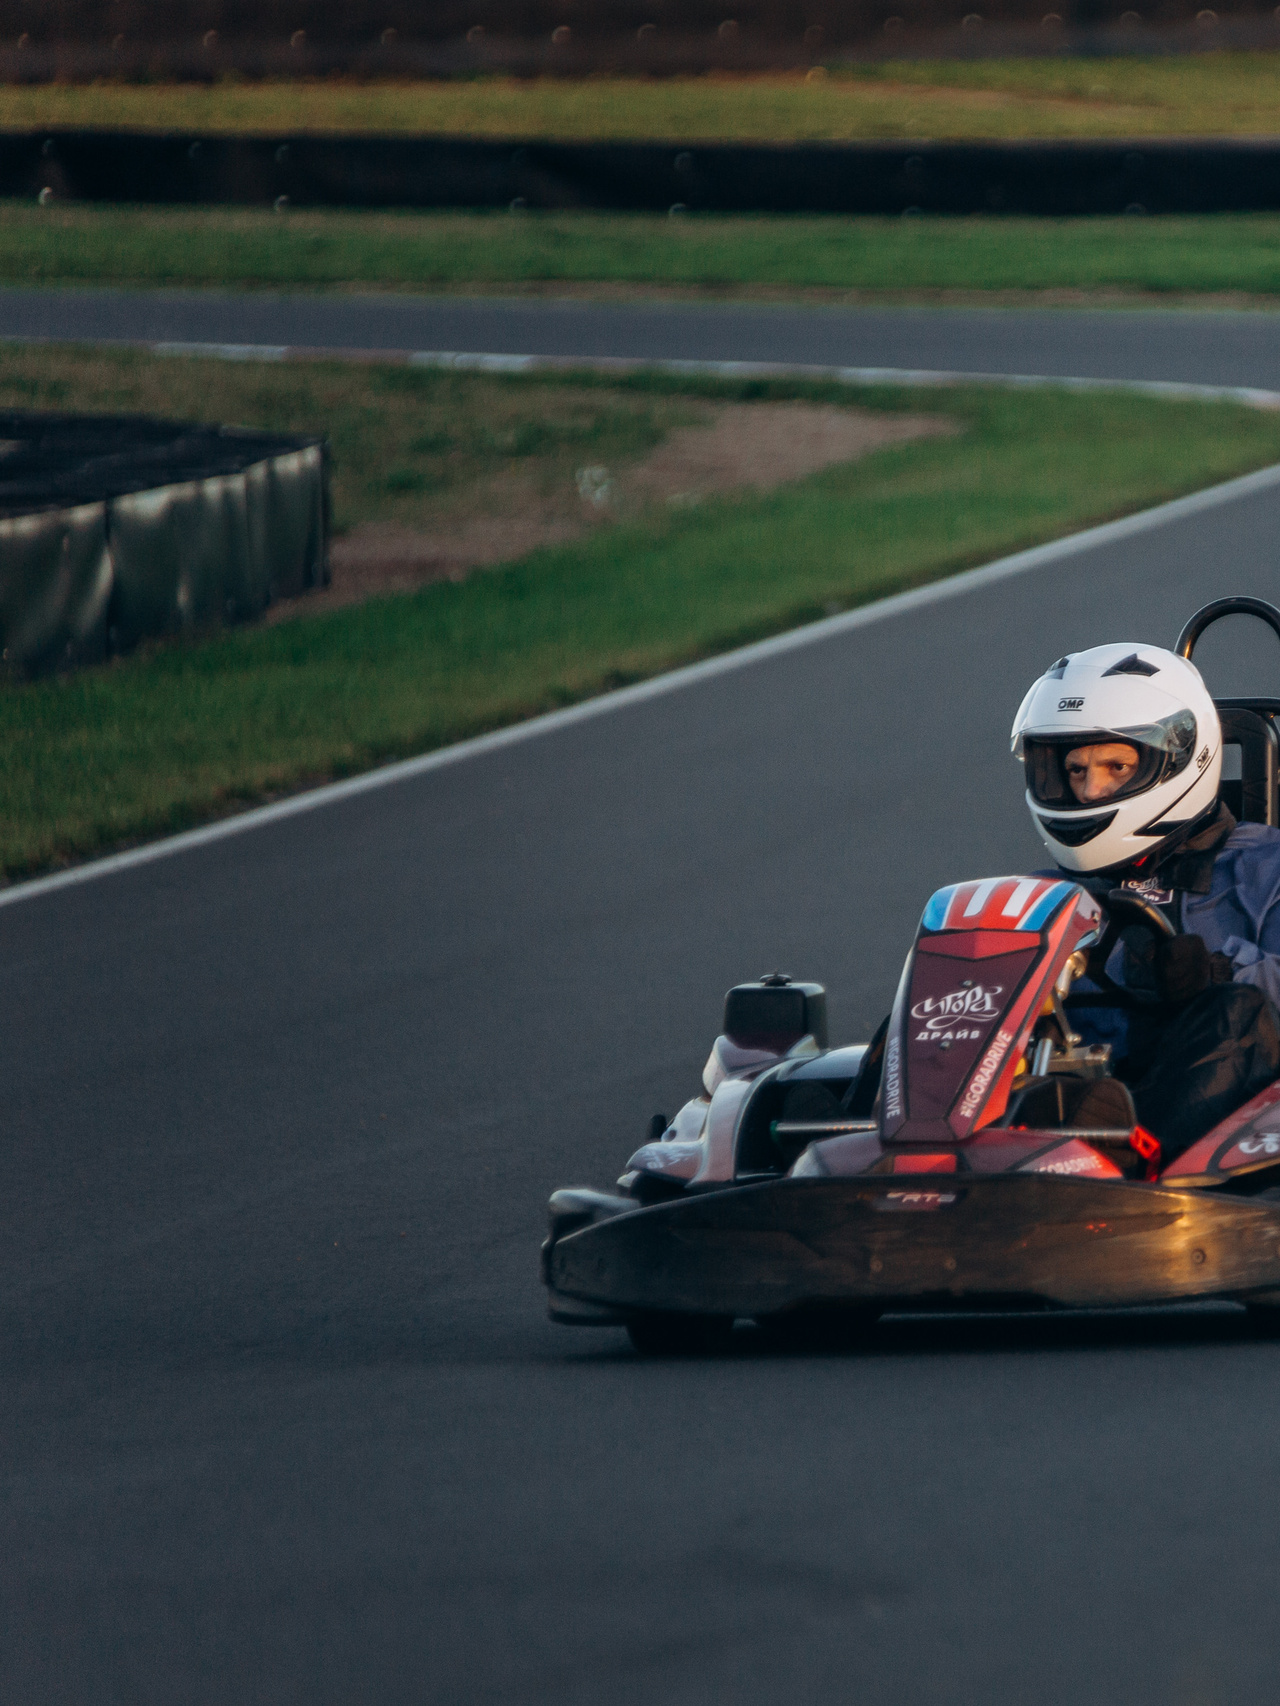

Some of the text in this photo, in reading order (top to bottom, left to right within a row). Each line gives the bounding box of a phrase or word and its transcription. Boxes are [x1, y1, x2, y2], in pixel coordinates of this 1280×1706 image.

[1058, 699, 1084, 709] OMP
[1197, 747, 1209, 768] OMP
[915, 1030, 981, 1041] ДРАЙВ
[886, 1036, 901, 1119] #IGORADRIVE
[960, 1030, 1013, 1118] #IGORADRIVE
